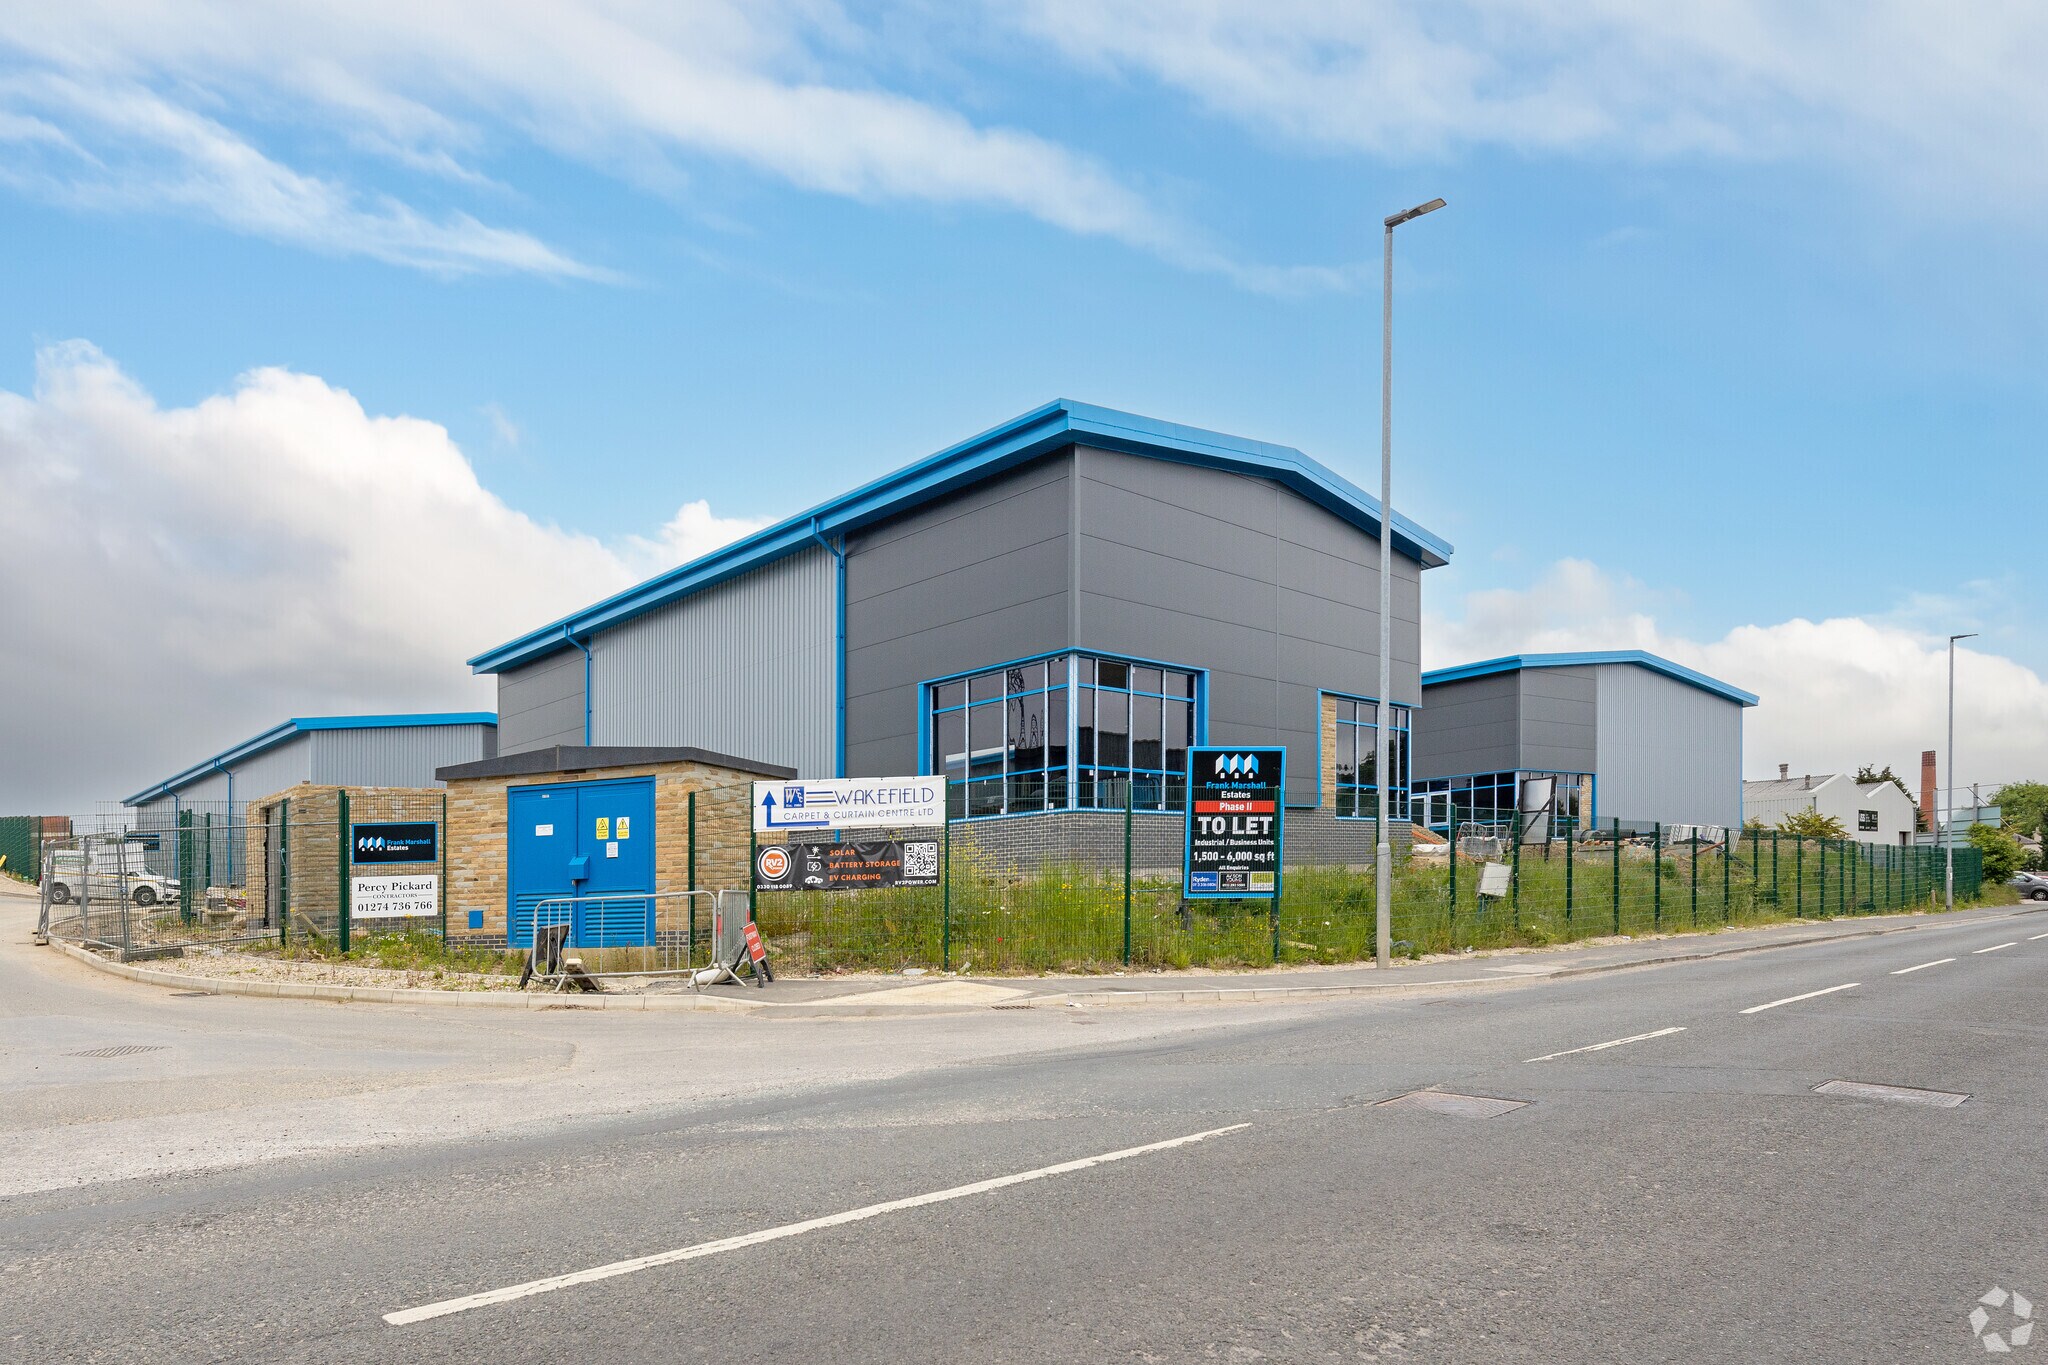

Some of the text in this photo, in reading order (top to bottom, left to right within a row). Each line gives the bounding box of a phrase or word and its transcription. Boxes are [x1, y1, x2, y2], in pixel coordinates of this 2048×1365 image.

[1206, 781, 1267, 790] Frank Marshall
[834, 787, 935, 805] WAKEFIELD
[1221, 790, 1251, 799] Estates
[1219, 802, 1245, 811] Phase
[783, 807, 934, 820] CARPET & CURTAIN CENTRE LTD
[1197, 816, 1273, 835] TO LET
[1194, 838, 1225, 846] Industrial
[1229, 838, 1257, 846] Business
[1257, 838, 1274, 846] Units
[829, 848, 856, 857] SOLAR
[1193, 851, 1219, 863] 1,500
[1226, 851, 1253, 863] 6,000
[1253, 853, 1265, 863] sq
[1266, 851, 1275, 861] ft
[765, 858, 783, 868] RV2
[829, 860, 900, 869] BATTERY STORAGE
[840, 873, 881, 881] CHARGING
[358, 881, 433, 894] Percy Pickard
[357, 900, 433, 912] 01274 736 766
